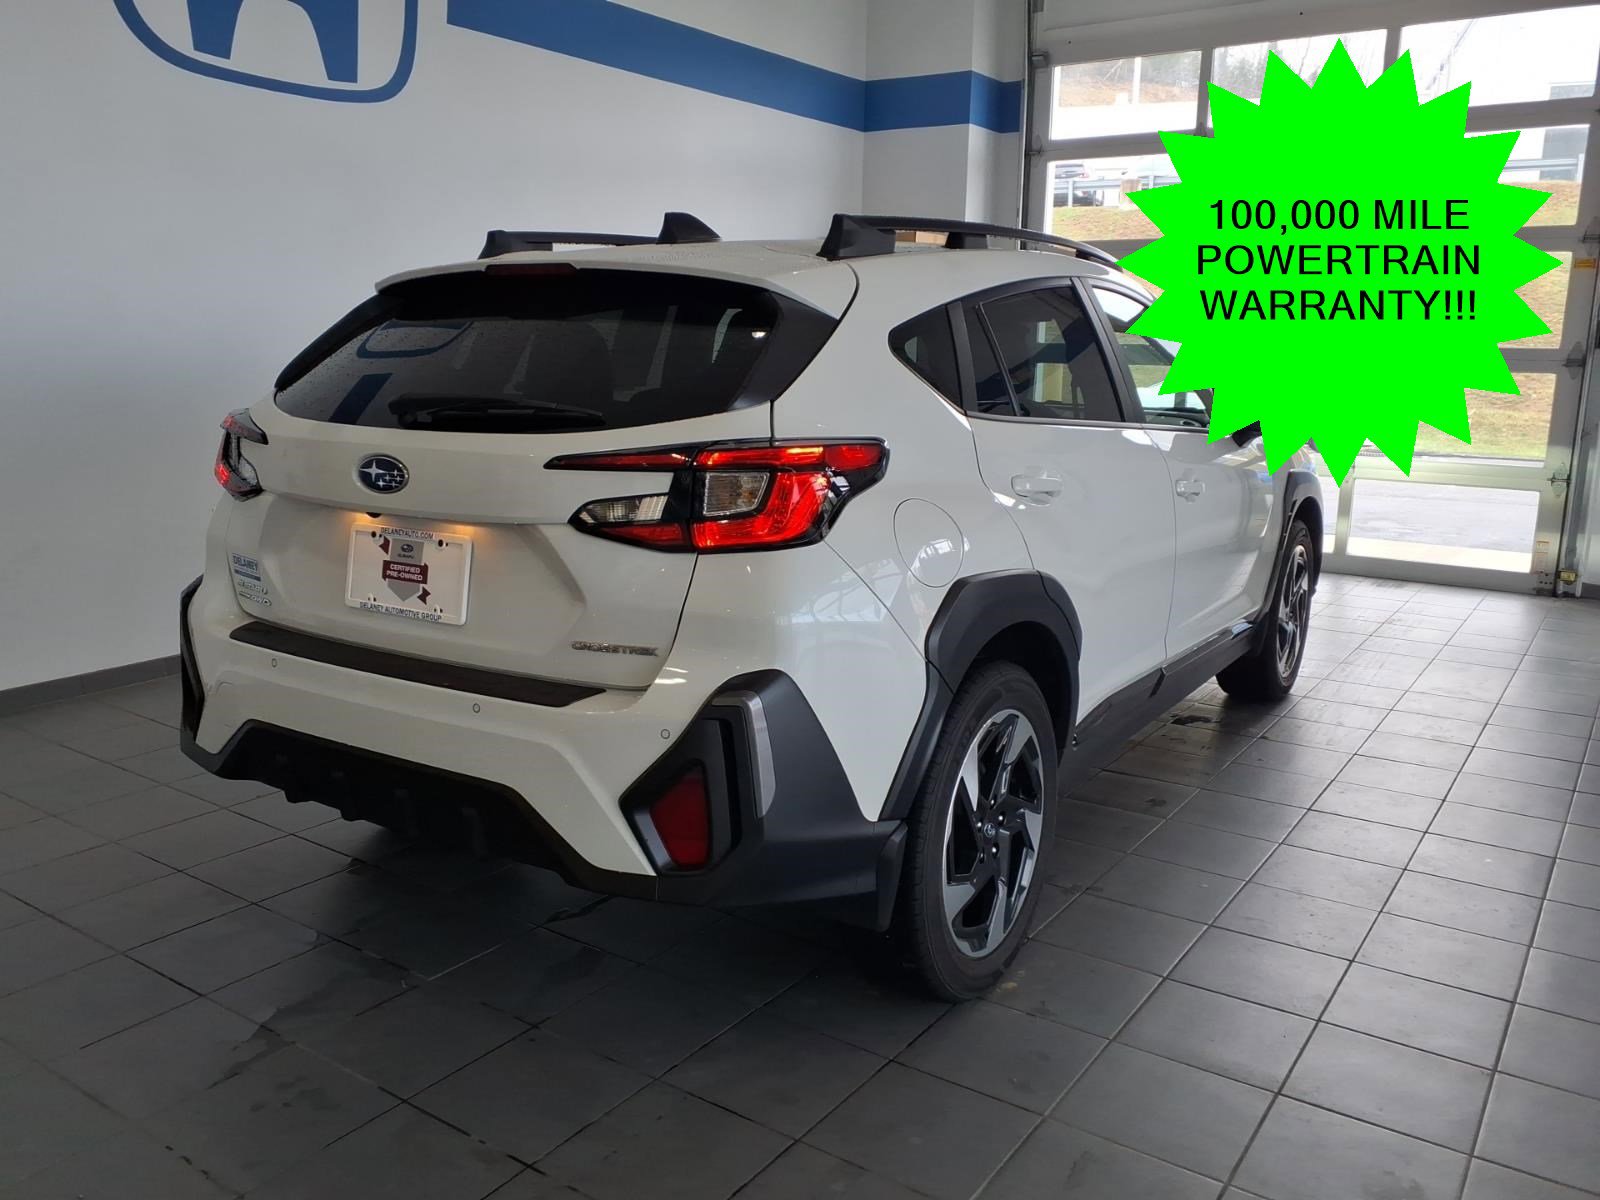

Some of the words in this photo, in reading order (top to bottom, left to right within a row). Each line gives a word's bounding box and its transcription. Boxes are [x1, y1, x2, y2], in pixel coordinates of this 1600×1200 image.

[390, 563, 421, 574] CERTIFIED
[386, 570, 423, 581] PRE-OWNED
[385, 606, 420, 617] AUTOMOTIVE
[421, 611, 442, 621] GROUP
